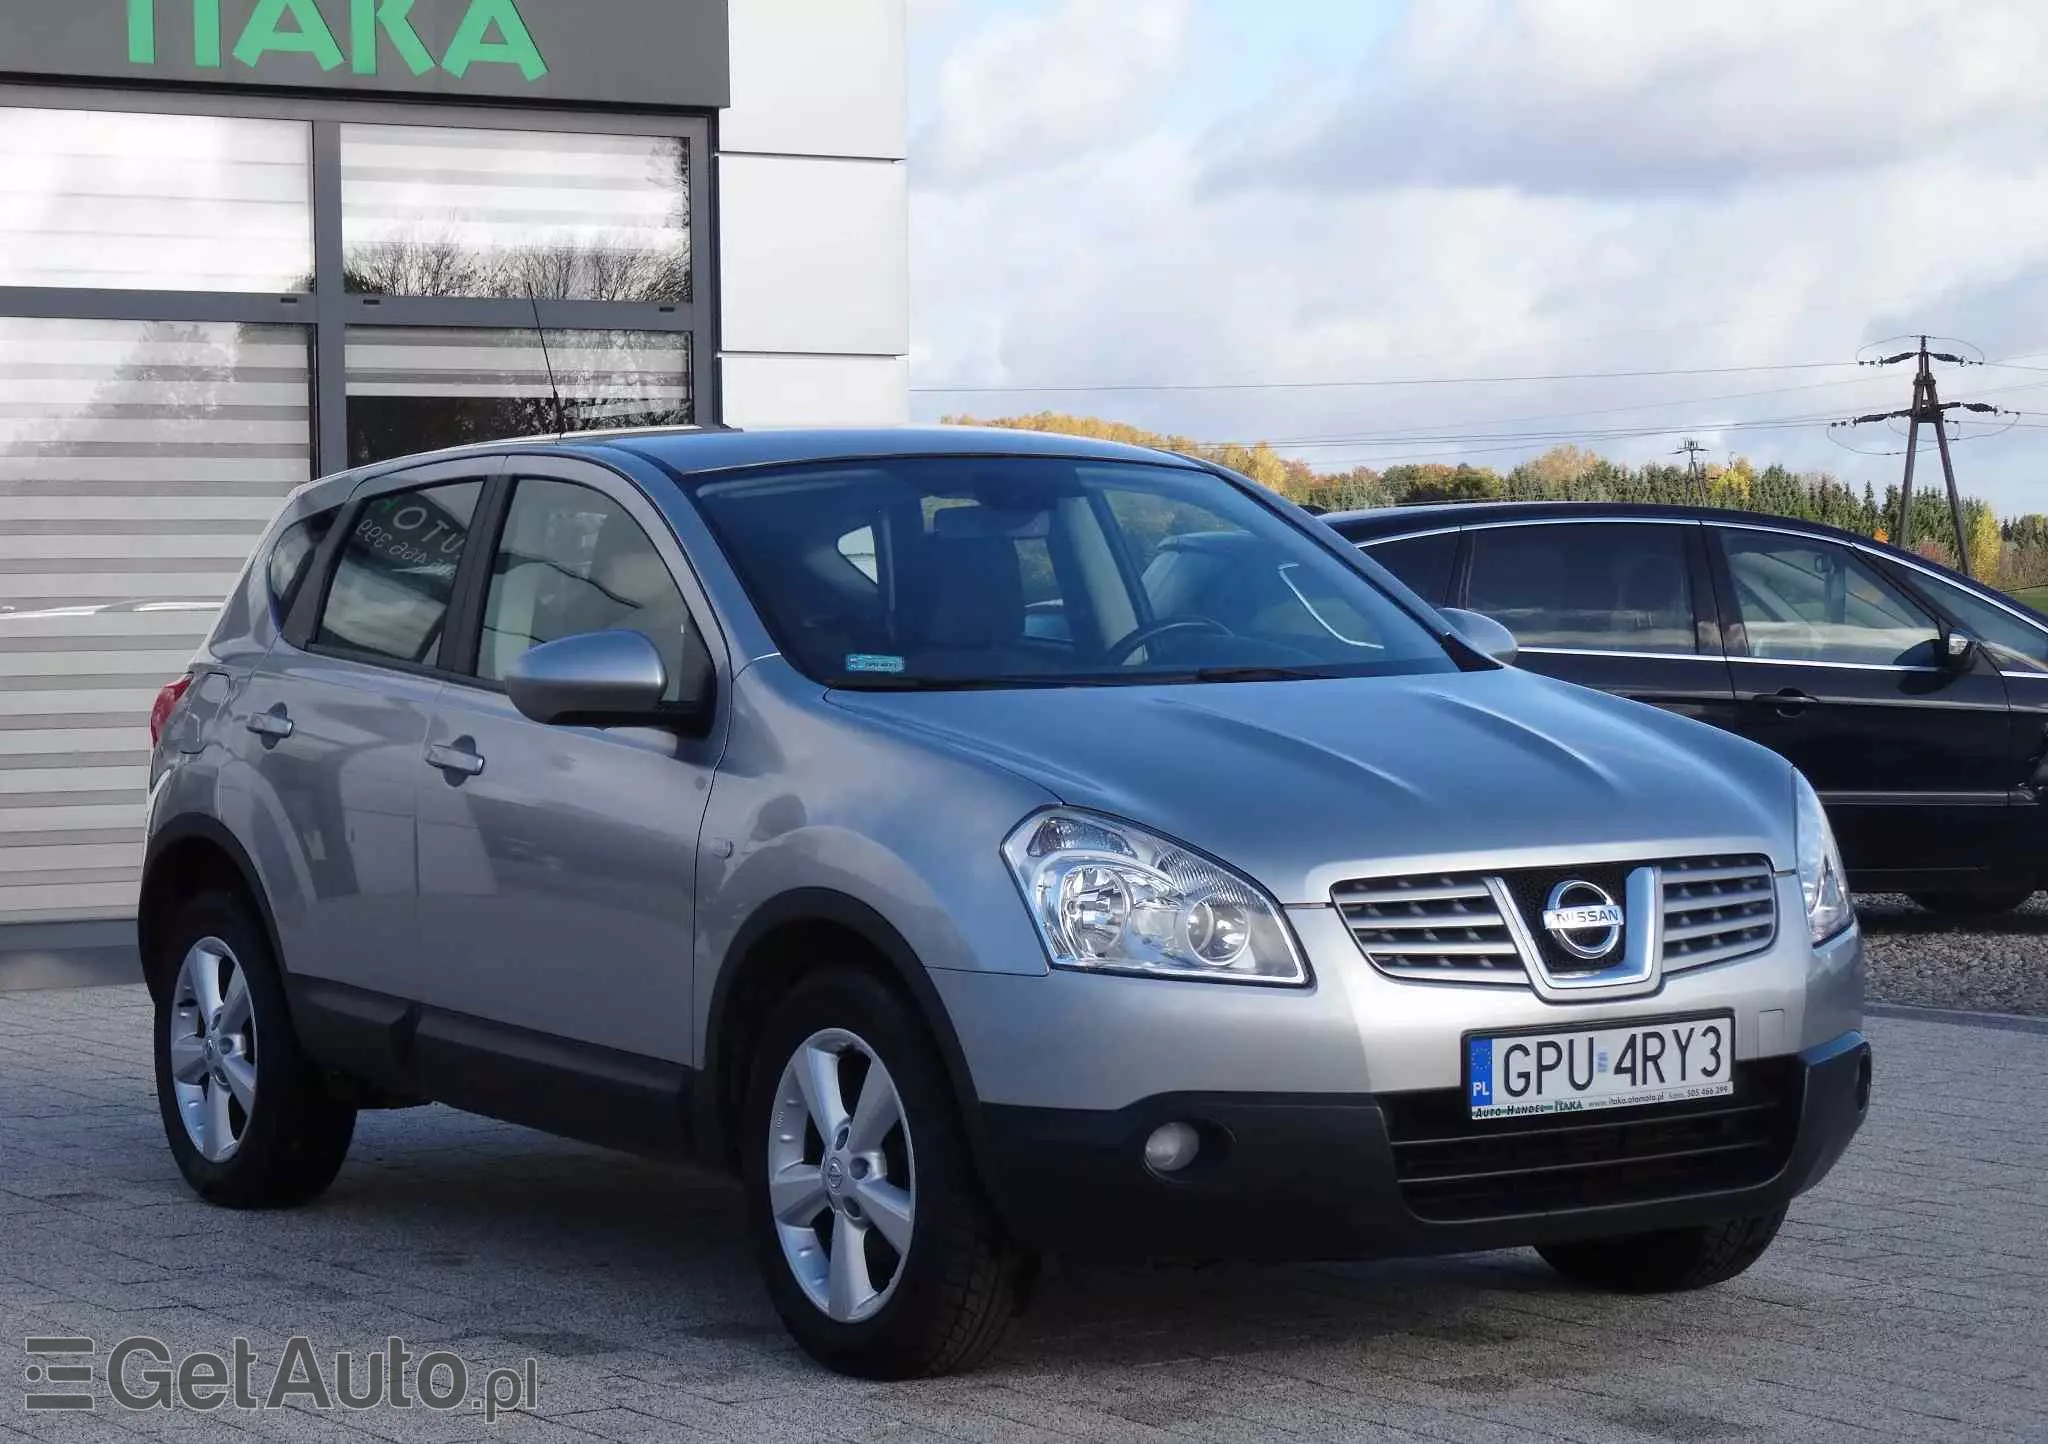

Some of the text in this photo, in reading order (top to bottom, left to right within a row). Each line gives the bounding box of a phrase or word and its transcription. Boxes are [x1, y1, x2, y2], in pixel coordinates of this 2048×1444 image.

[1556, 909, 1619, 923] NISSAN
[1503, 1025, 1722, 1098] GPU 4RY3
[1473, 1081, 1490, 1097] PL
